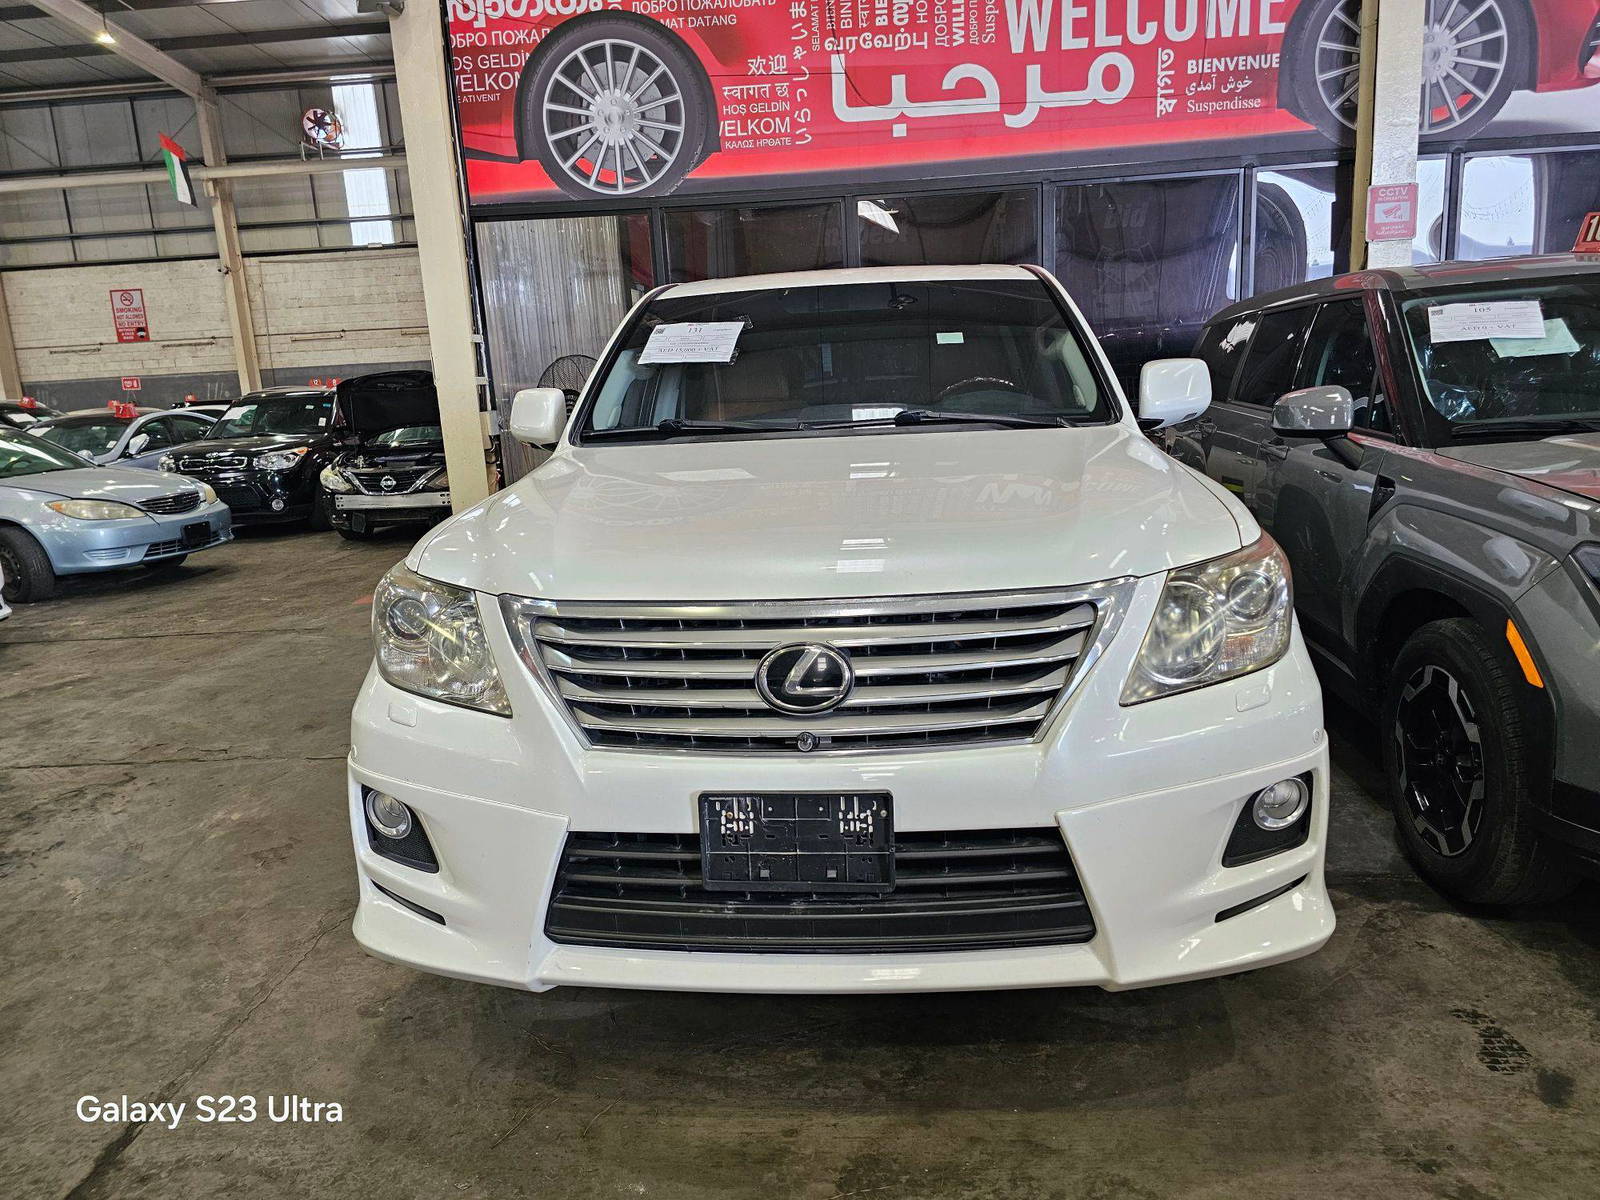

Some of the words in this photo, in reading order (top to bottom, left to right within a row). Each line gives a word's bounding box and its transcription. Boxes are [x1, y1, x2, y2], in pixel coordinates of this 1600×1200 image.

[688, 14, 737, 28] DATANG
[840, 0, 852, 28] BIN
[810, 4, 820, 51] SELAMAT
[1005, 0, 1286, 54] WELCOME
[747, 54, 789, 76] 欢迎
[1187, 53, 1280, 75] BIENVENUE
[456, 71, 520, 92] ELKO
[1221, 75, 1253, 93] خوش
[722, 84, 771, 100] स्वागत
[830, 51, 1135, 138] مرحبا
[723, 104, 746, 116] HOŞ
[749, 100, 790, 113] GELDİN
[1187, 96, 1261, 114] Suspendisse
[719, 117, 790, 136] ELKOM
[1379, 187, 1408, 197] CCTV
